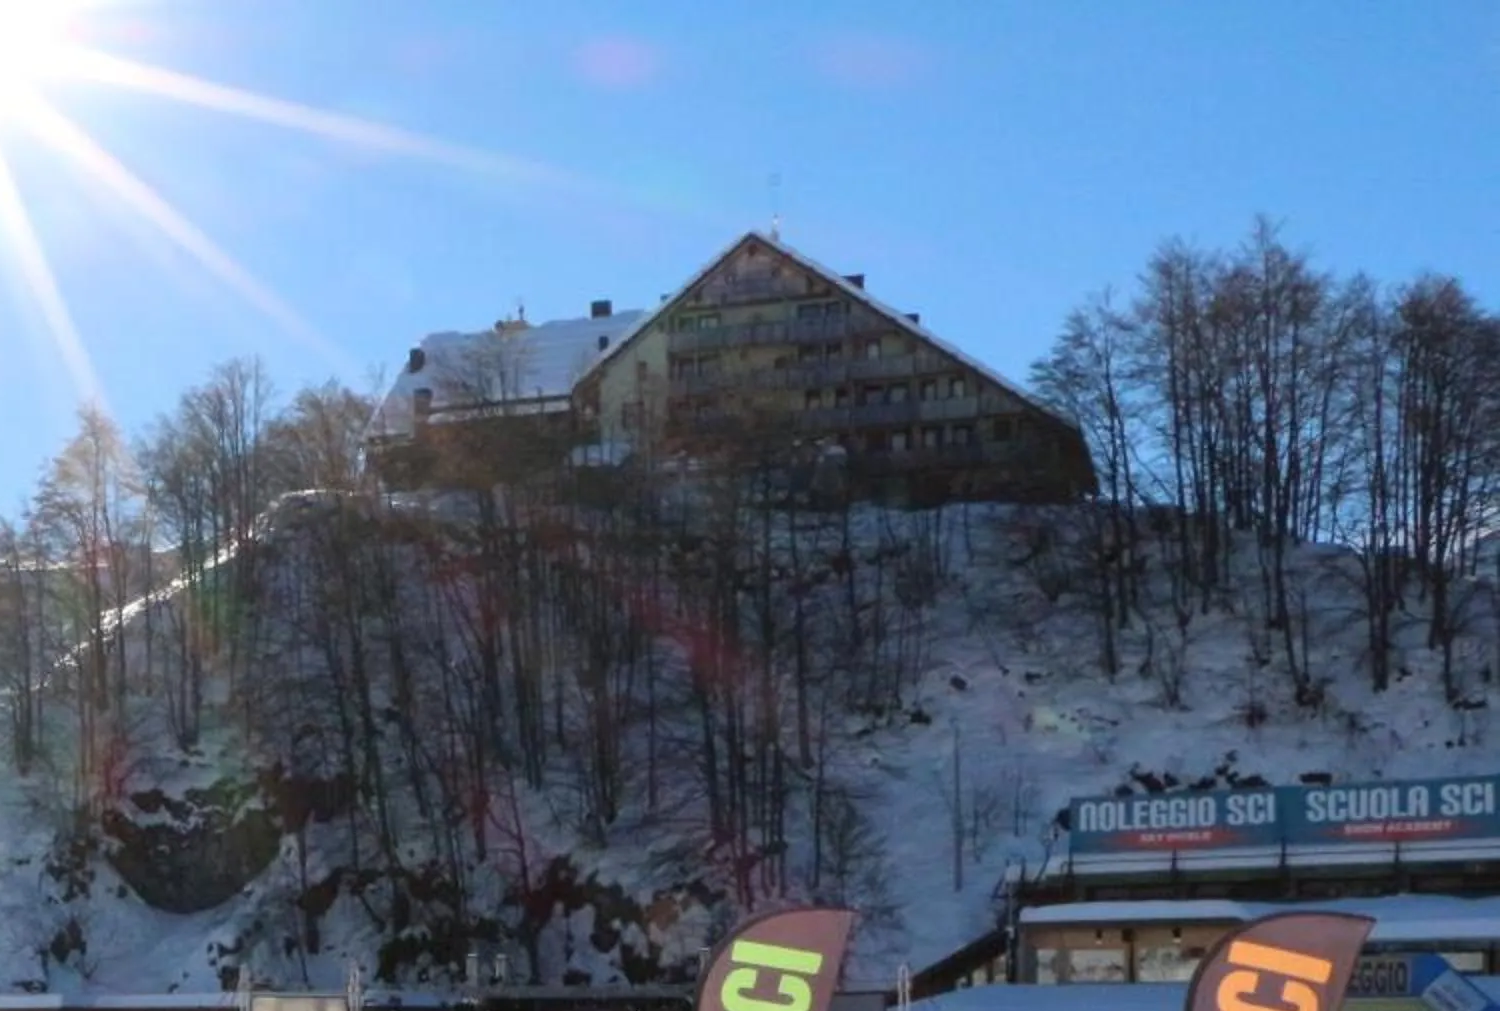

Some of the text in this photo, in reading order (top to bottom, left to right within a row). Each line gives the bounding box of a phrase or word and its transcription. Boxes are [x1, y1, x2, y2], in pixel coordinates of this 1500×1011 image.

[1079, 793, 1276, 832] NOLEGGIO SCI
[1305, 782, 1495, 823] SCUOLA SCI
